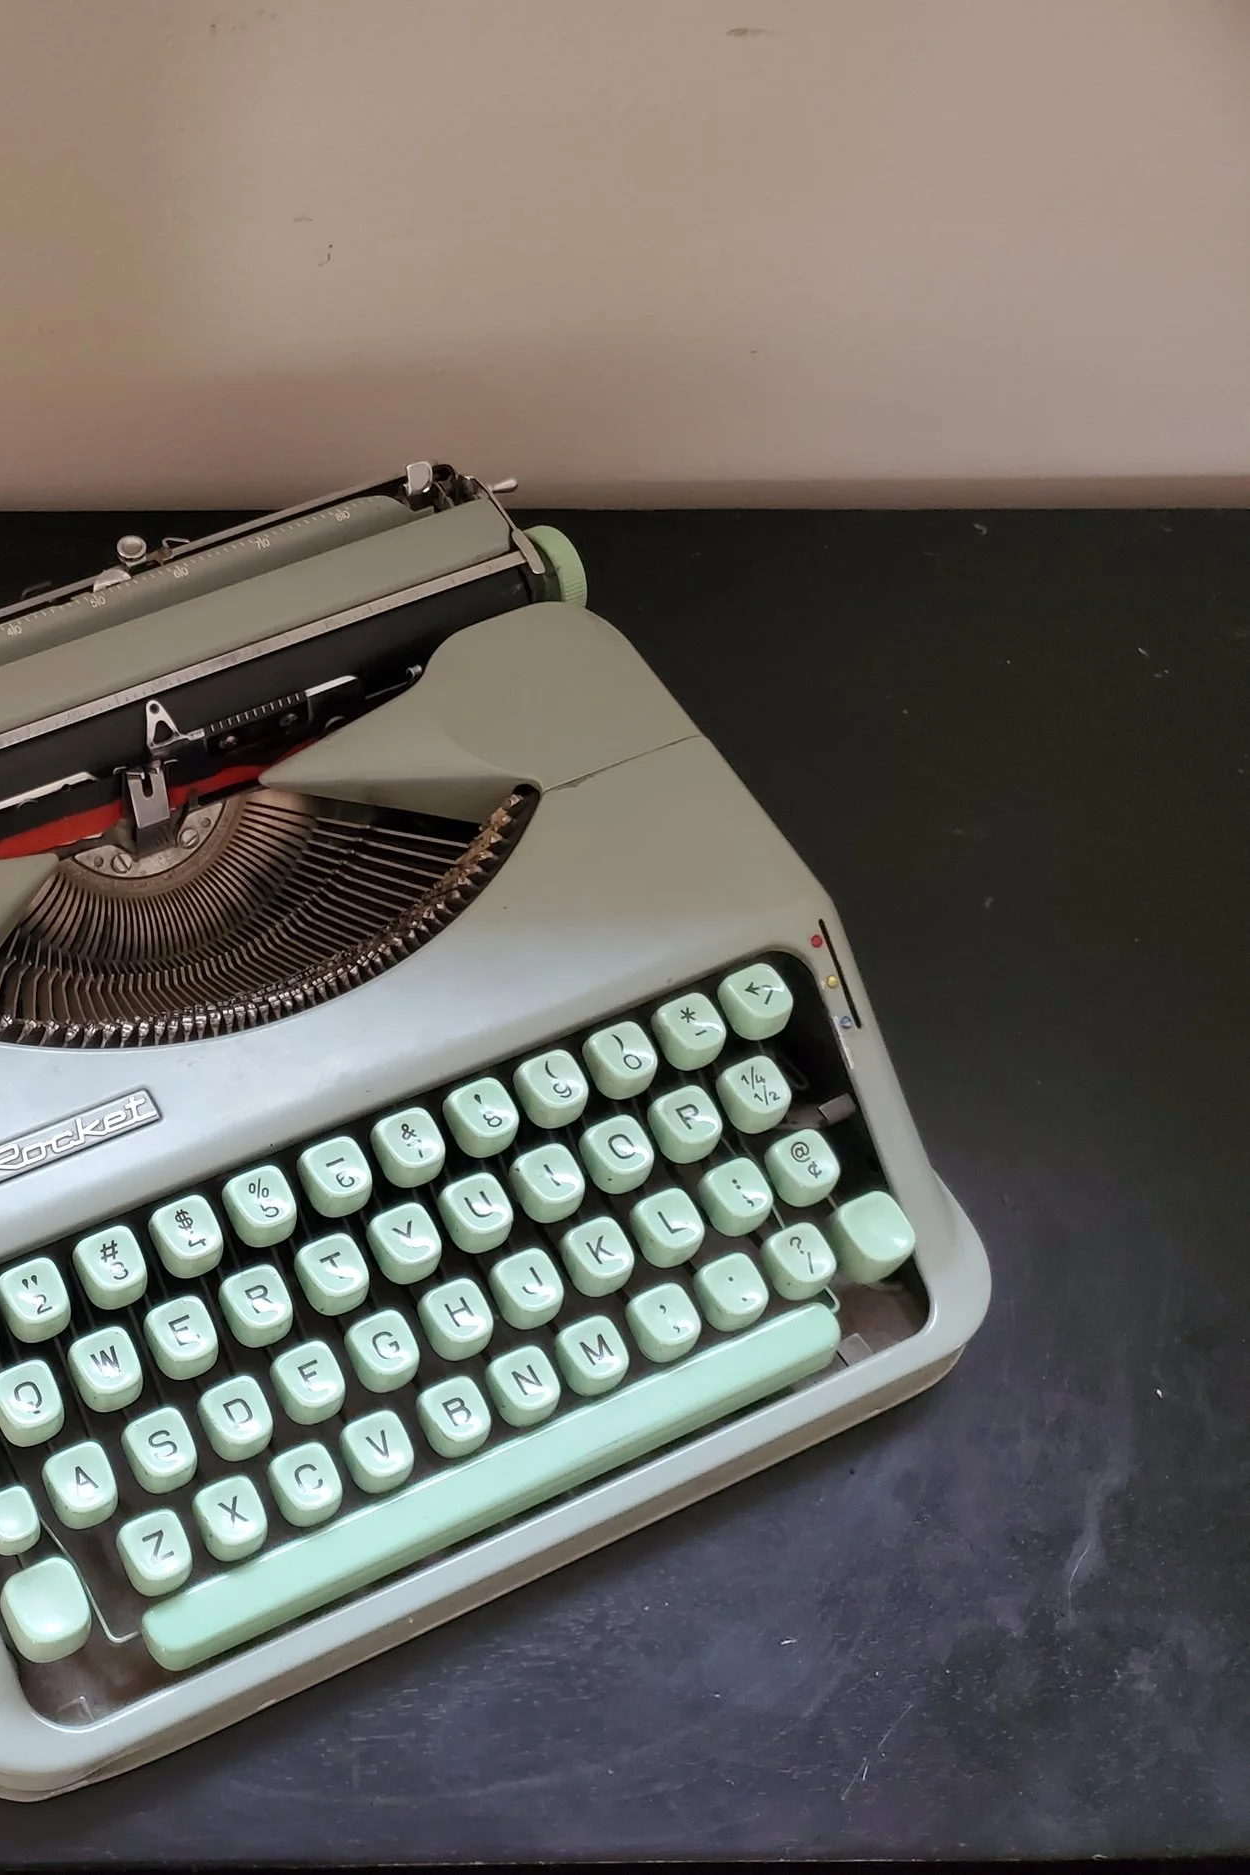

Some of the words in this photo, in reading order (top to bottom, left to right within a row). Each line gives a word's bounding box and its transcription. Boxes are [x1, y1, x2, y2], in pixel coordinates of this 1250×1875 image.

[7, 624, 22, 637] 40
[400, 1123, 417, 1140] &
[675, 1103, 700, 1131] P
[791, 1141, 811, 1163] @
[248, 1178, 270, 1199] %
[463, 1190, 493, 1219] U
[175, 1208, 193, 1231] $
[657, 1210, 688, 1235] L
[100, 1240, 119, 1263] #
[585, 1235, 616, 1265] K
[789, 1235, 806, 1255] ?
[109, 1261, 129, 1280] 3
[320, 1251, 344, 1279] T
[521, 1266, 544, 1296] J
[34, 1294, 53, 1315] 2
[244, 1284, 275, 1314] R
[444, 1296, 475, 1328] H
[168, 1314, 200, 1347] E
[371, 1331, 402, 1360] G
[578, 1333, 615, 1366] M
[89, 1345, 121, 1377] W
[297, 1359, 319, 1391] F
[511, 1364, 544, 1396] N
[13, 1381, 43, 1415] Q
[441, 1396, 472, 1428] B
[222, 1397, 254, 1430] D
[147, 1429, 178, 1458] S
[364, 1429, 390, 1459] V
[75, 1465, 100, 1494] A
[293, 1463, 324, 1491] C
[217, 1495, 249, 1528] X
[141, 1529, 176, 1562] Z
